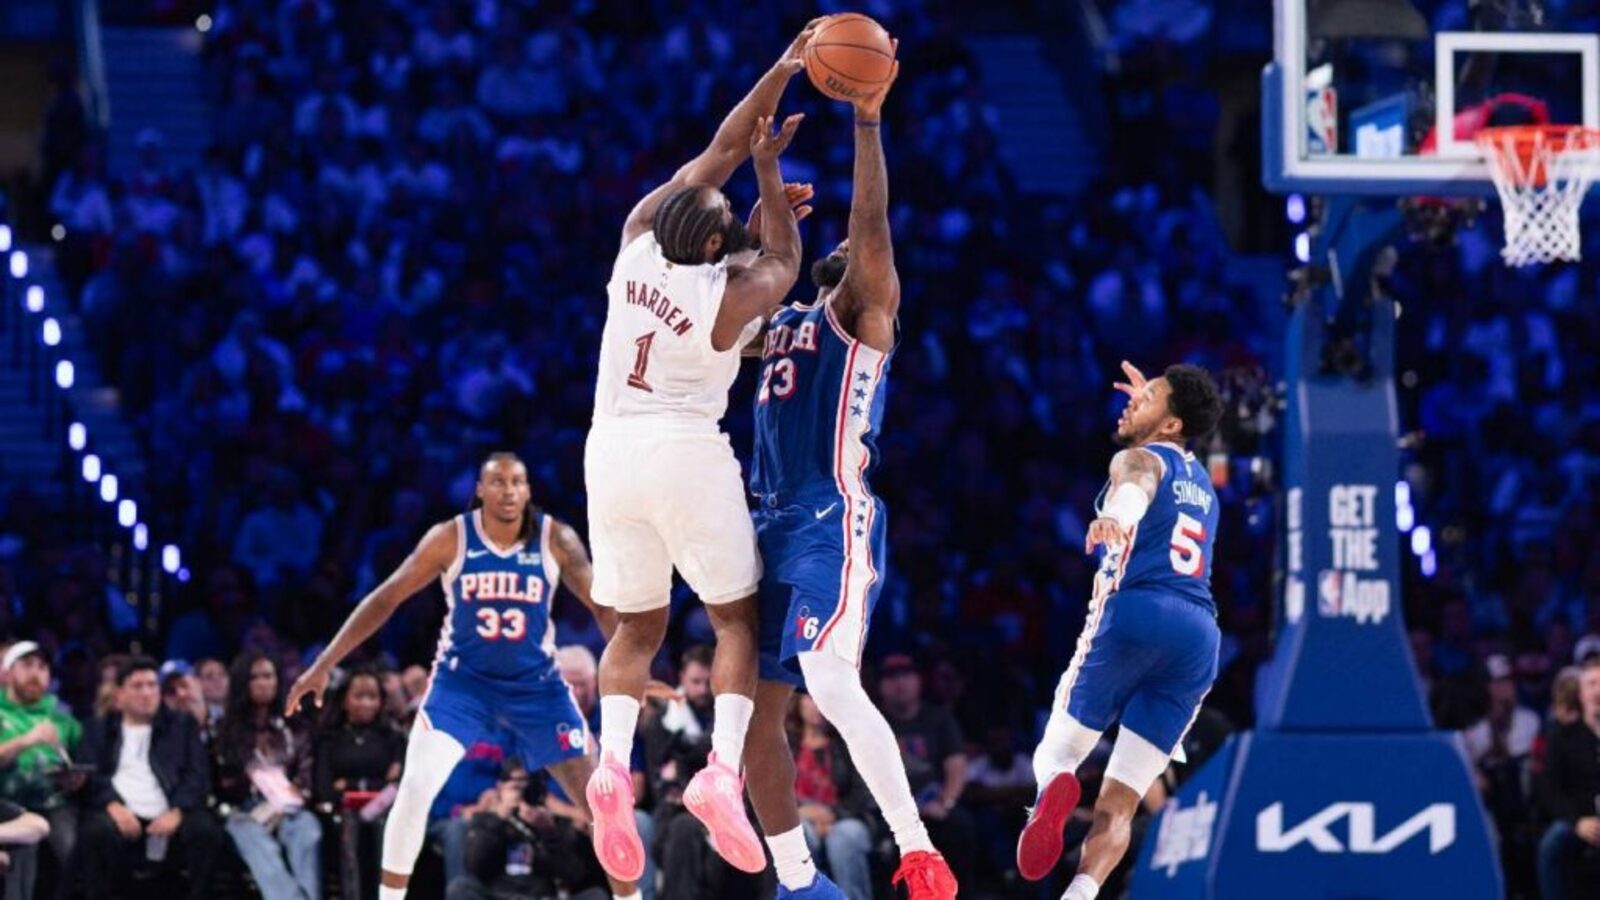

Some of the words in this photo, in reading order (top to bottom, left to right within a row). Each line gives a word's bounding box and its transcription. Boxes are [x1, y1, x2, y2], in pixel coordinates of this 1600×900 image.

[626, 280, 693, 337] HARDEN
[627, 330, 656, 393] 1
[1330, 484, 1378, 527] GET
[1169, 511, 1206, 577] 5
[1329, 527, 1379, 570] THE
[476, 607, 527, 640] 33
[1343, 571, 1390, 624] App
